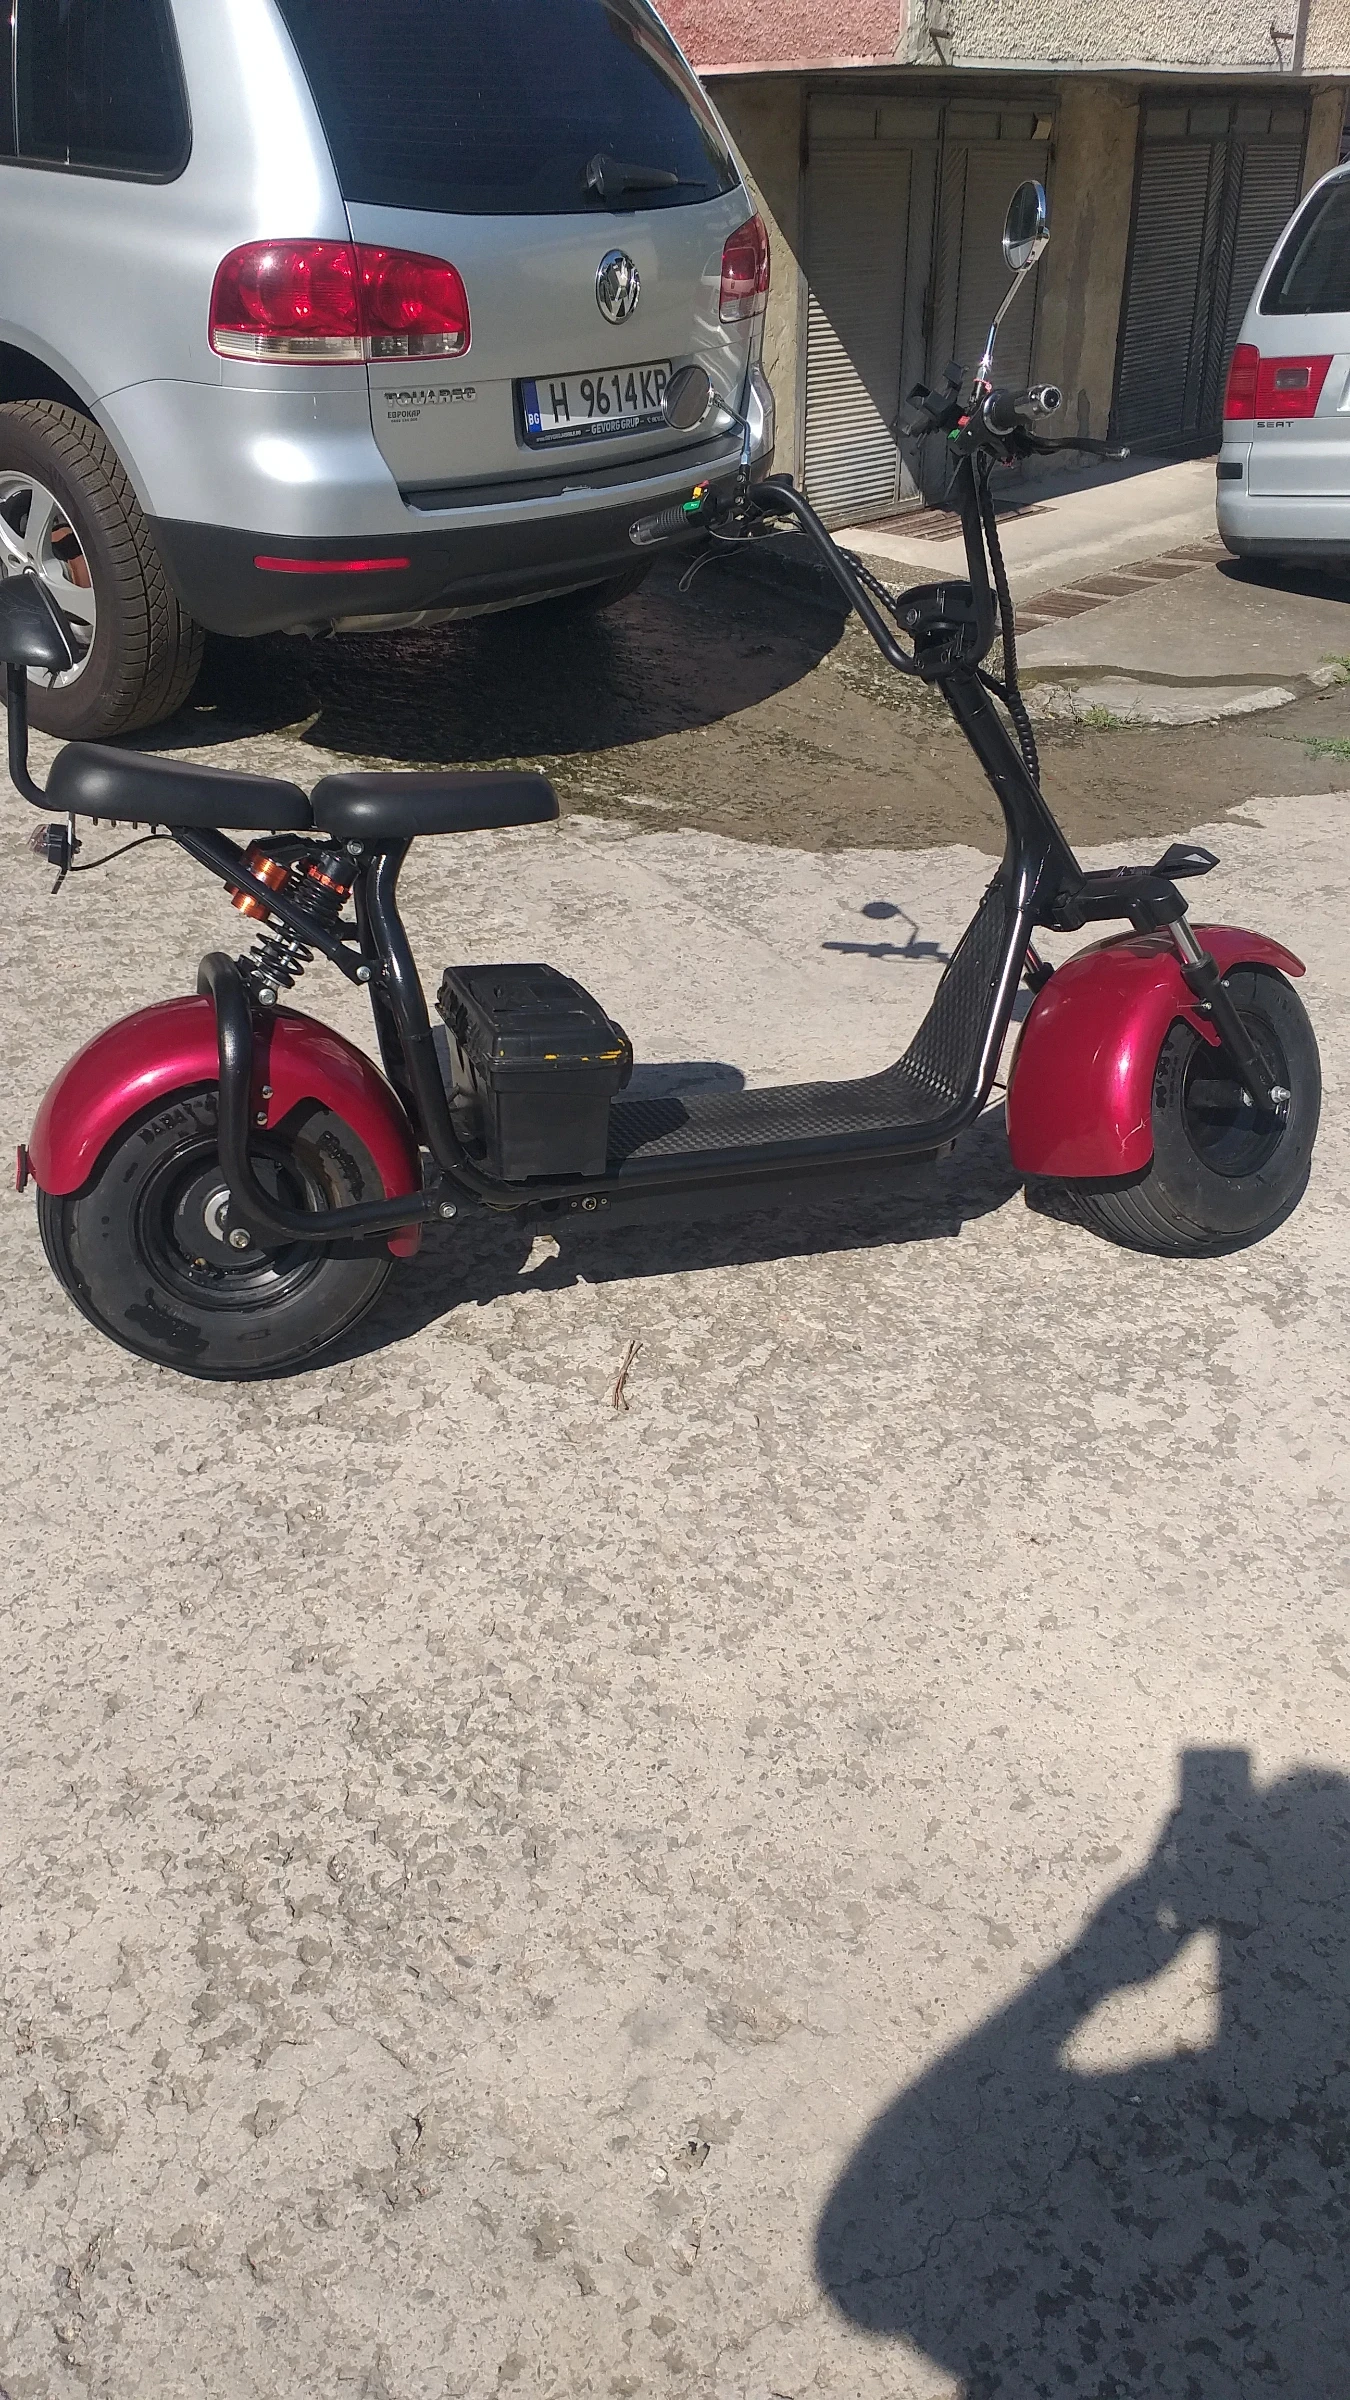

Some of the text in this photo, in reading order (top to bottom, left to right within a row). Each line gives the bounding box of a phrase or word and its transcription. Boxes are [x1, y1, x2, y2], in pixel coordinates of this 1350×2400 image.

[384, 387, 476, 408] TOUAREG
[550, 381, 570, 423] H
[528, 413, 540, 426] BG
[591, 419, 620, 434] GEVORG
[621, 417, 639, 432] GRUP
